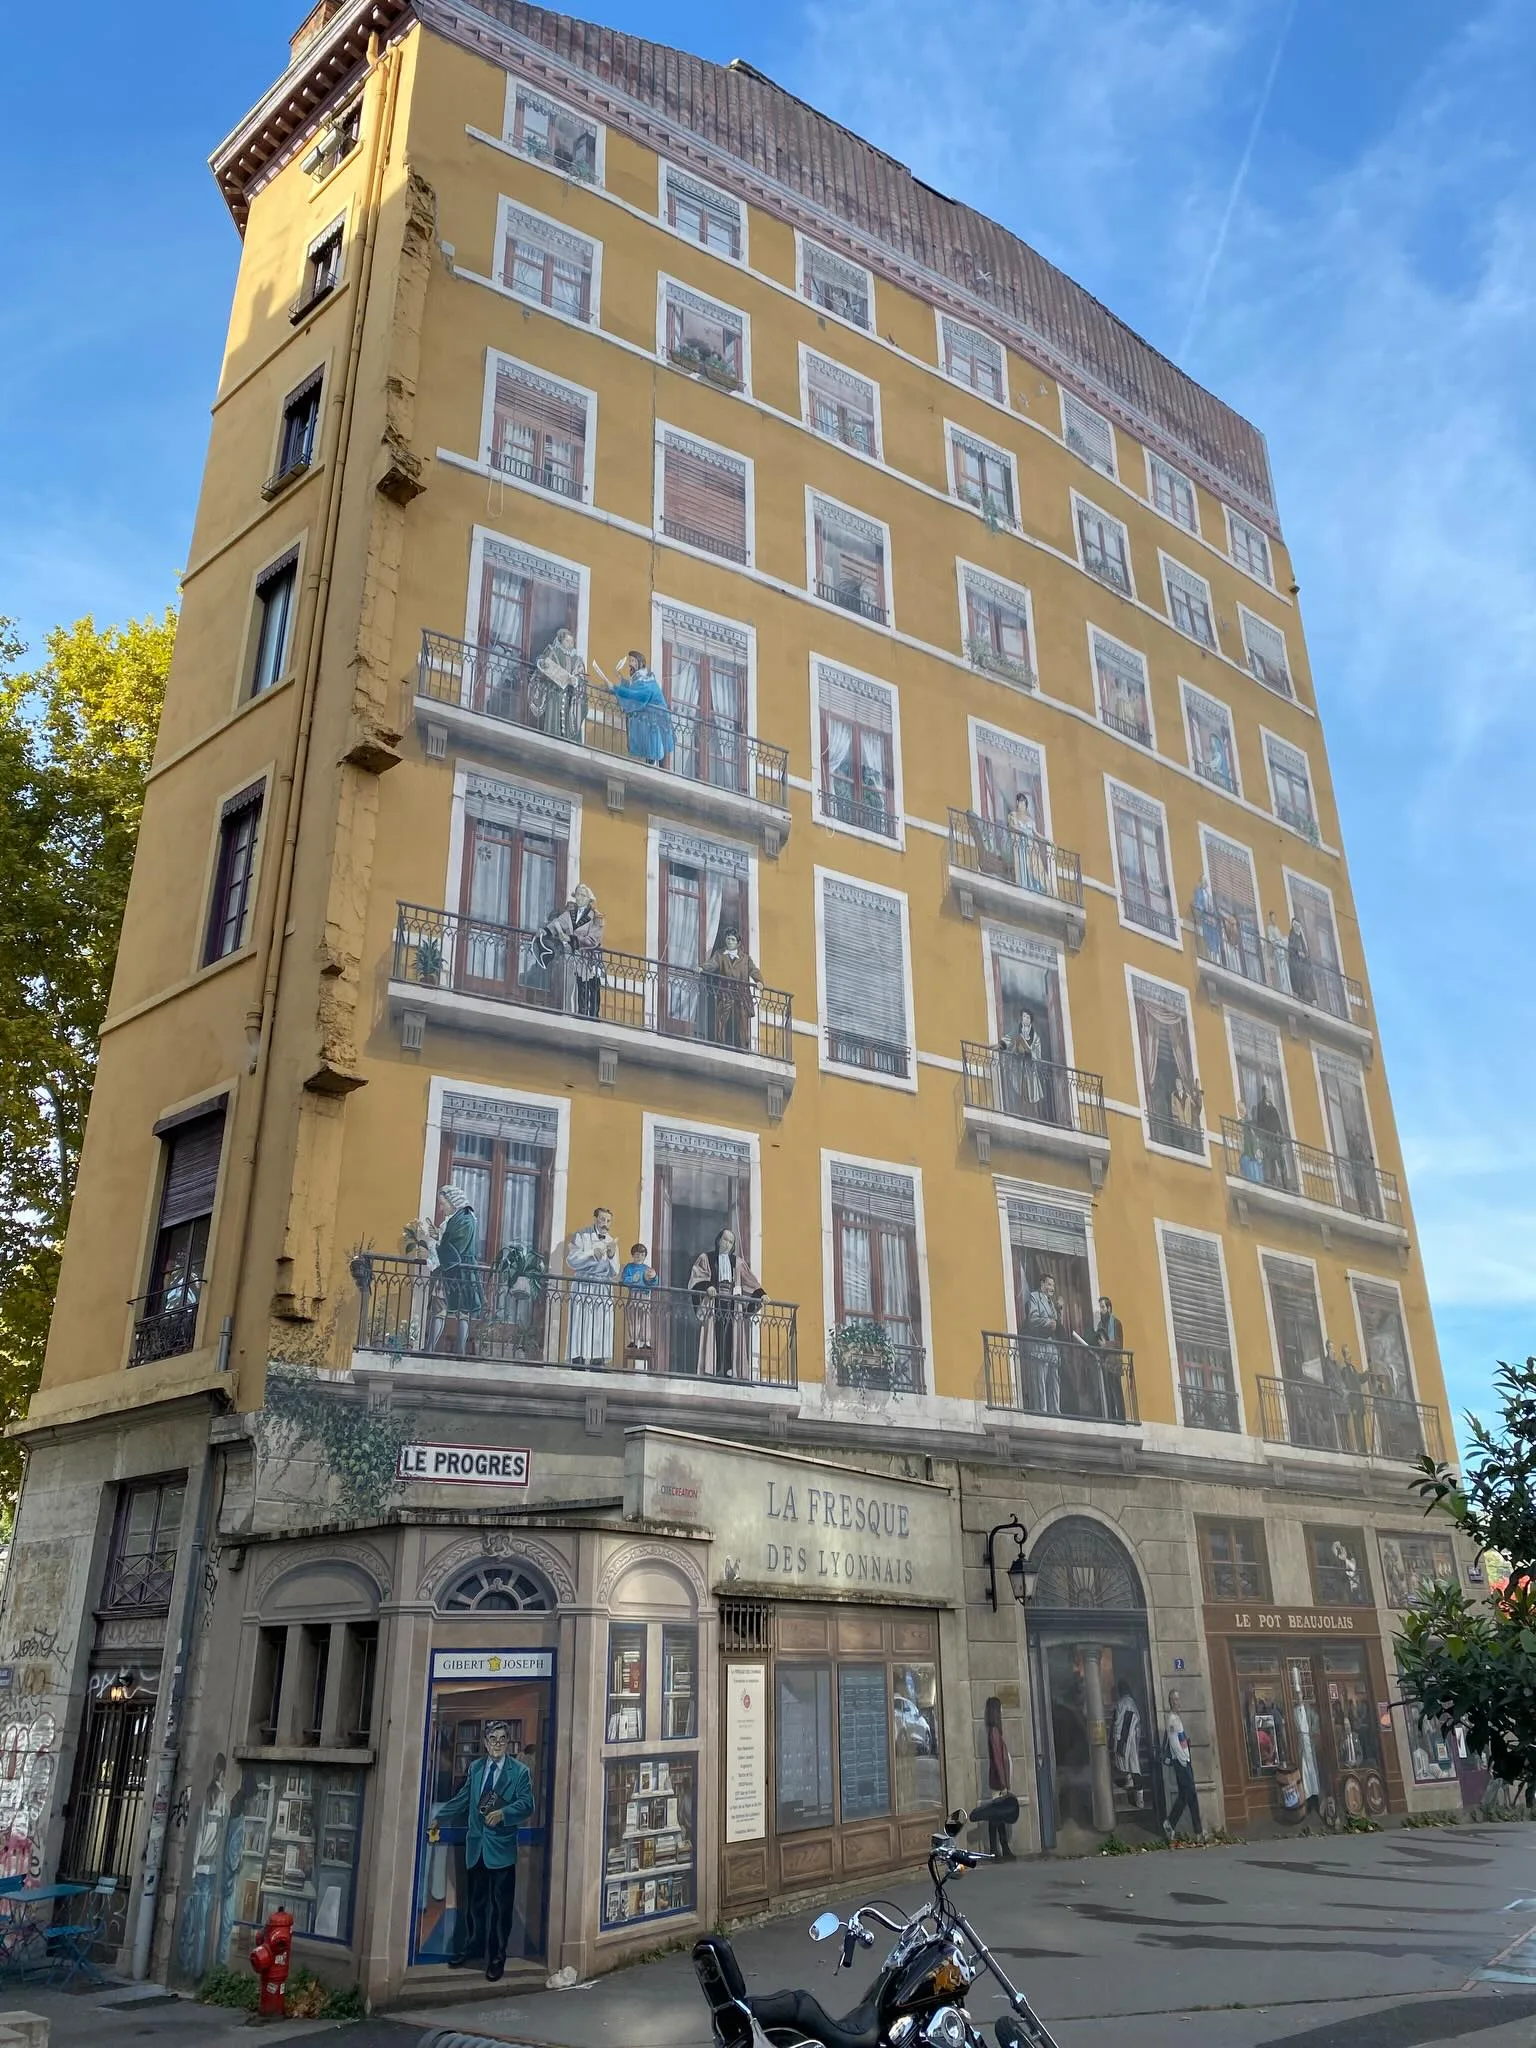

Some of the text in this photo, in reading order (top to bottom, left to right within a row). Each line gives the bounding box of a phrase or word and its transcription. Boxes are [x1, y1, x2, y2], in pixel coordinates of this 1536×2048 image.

[403, 1451, 427, 1471] LE
[767, 1481, 910, 1539] LA FRESQUE
[767, 1543, 913, 1584] DES LYONNAIS
[1235, 1614, 1354, 1629] LE POT BEAUJOLAIS
[443, 1659, 544, 1670] GIBERT JOSEPH
